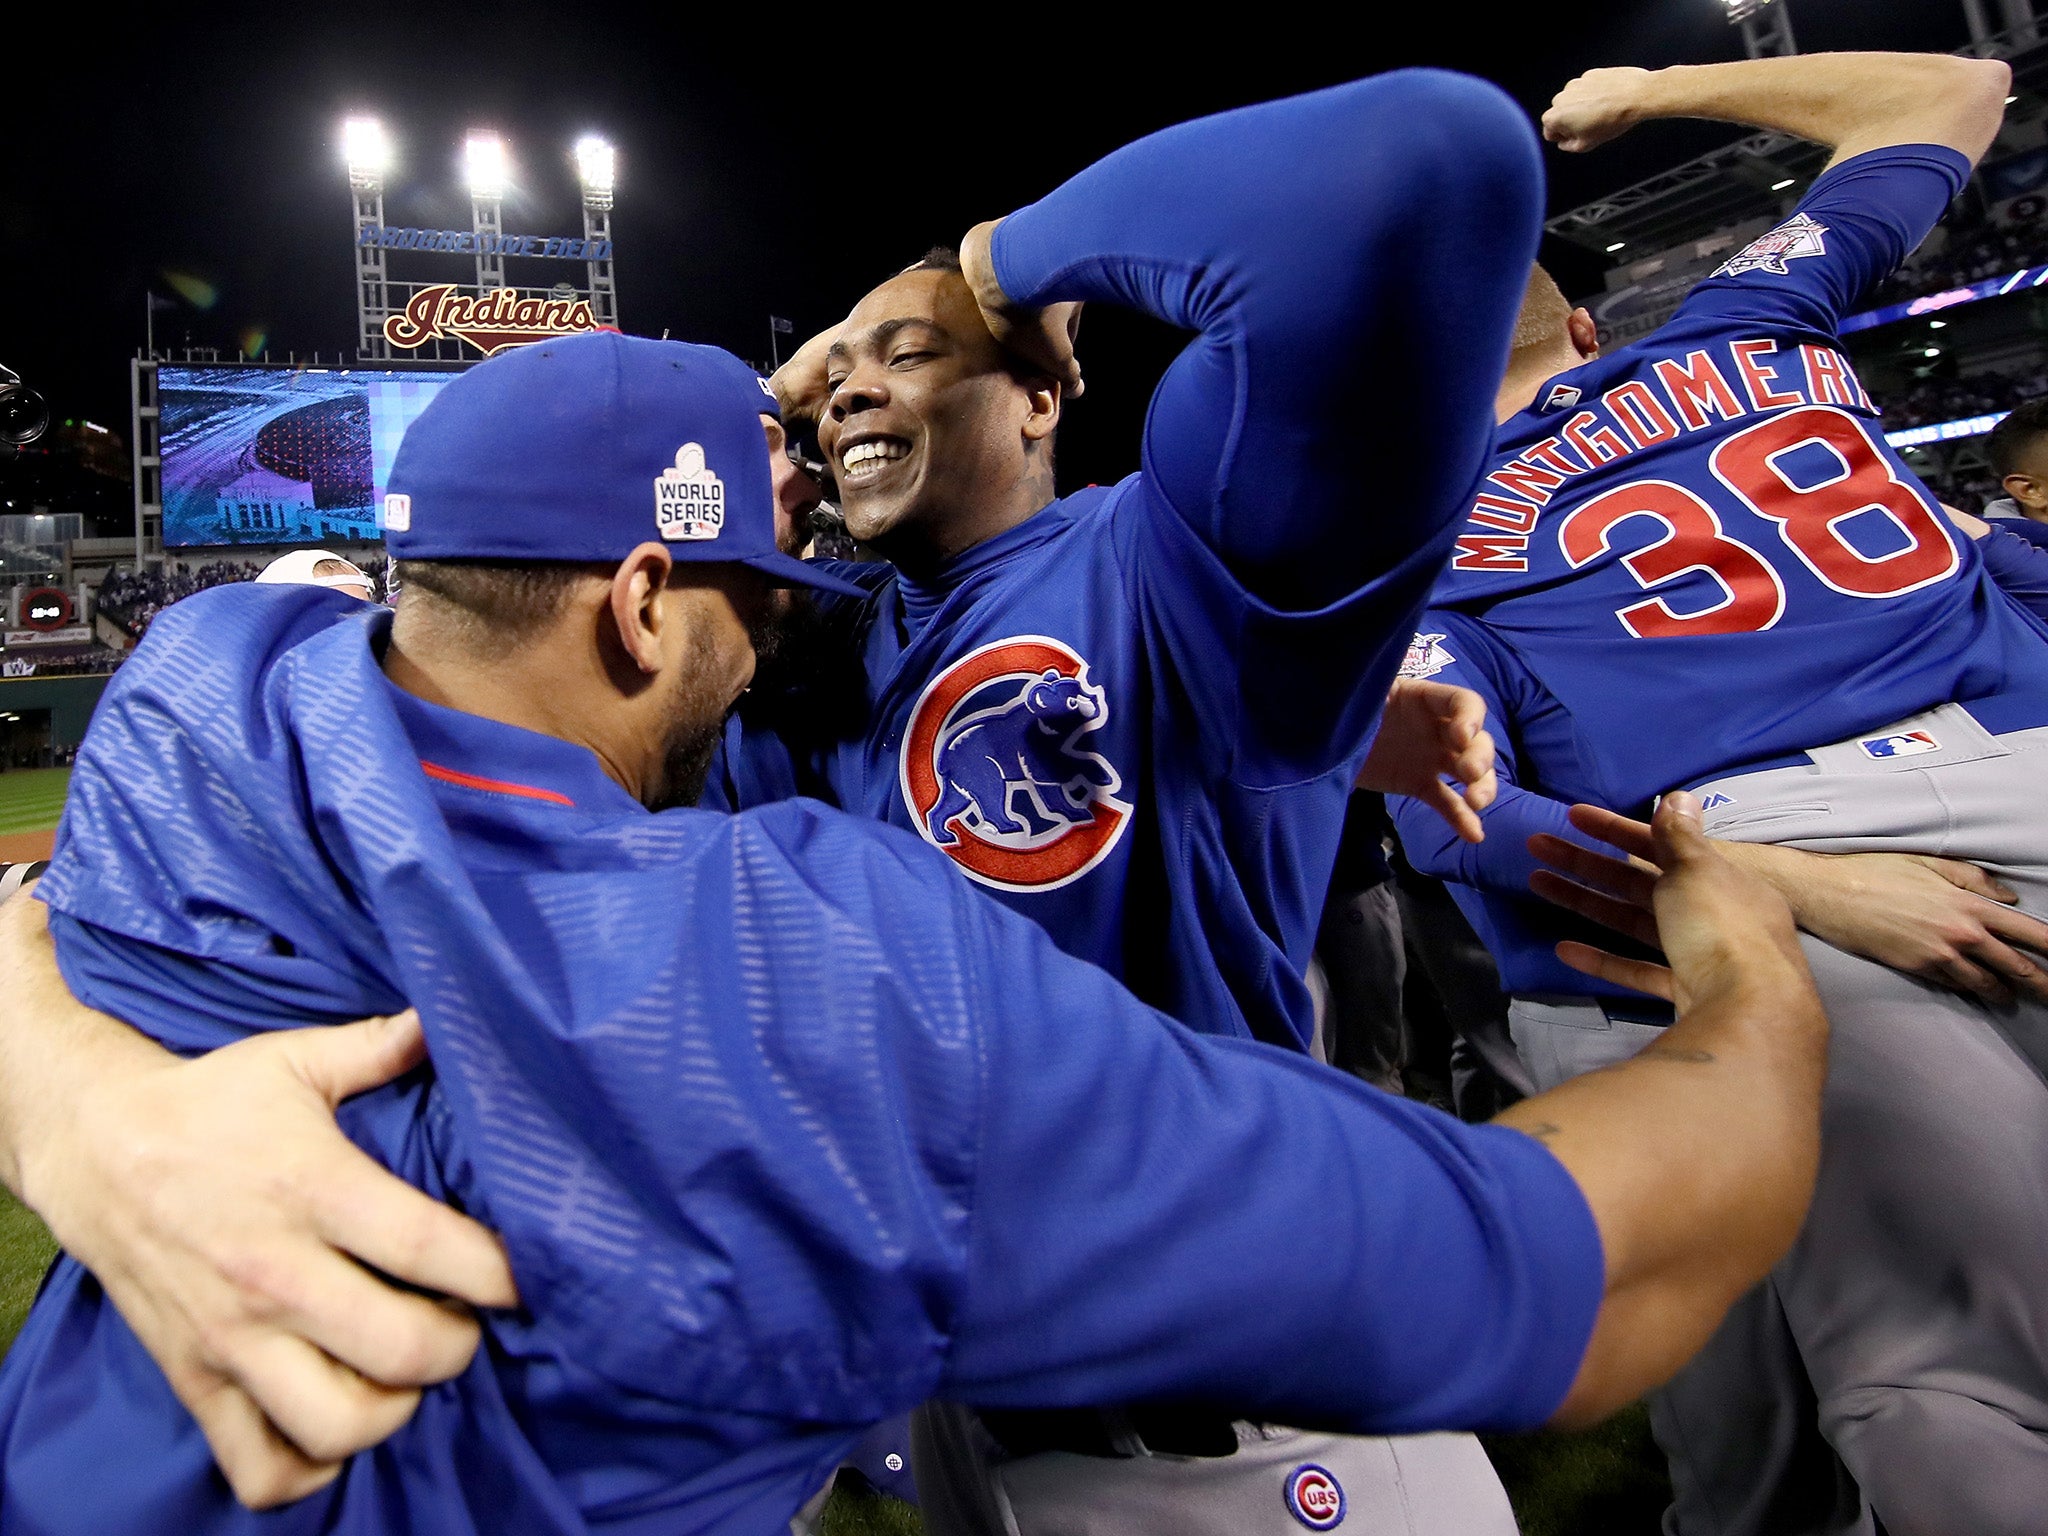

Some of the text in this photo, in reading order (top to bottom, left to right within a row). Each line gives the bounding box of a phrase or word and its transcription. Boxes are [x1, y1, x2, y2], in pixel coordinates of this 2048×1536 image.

[543, 236, 613, 261] FIELD
[383, 284, 600, 349] Indians
[1452, 339, 1881, 572] MONTGOMER
[660, 484, 721, 500] WORLD
[661, 503, 721, 525] SERIES
[1558, 405, 1960, 639] 38
[1297, 1474, 1338, 1520] CUBS
